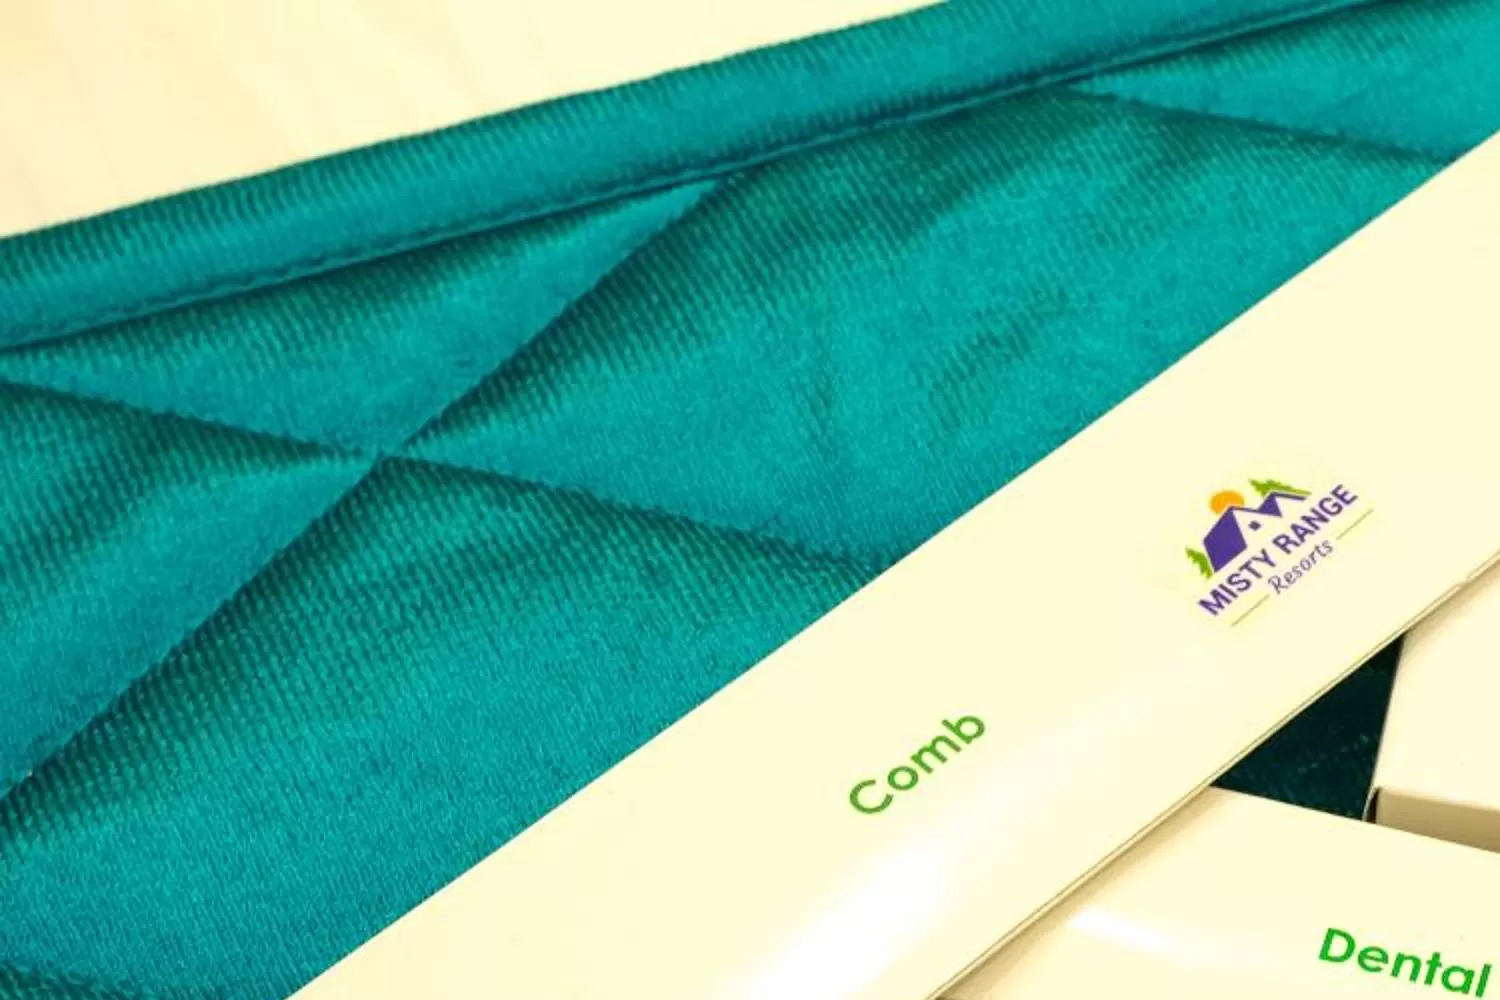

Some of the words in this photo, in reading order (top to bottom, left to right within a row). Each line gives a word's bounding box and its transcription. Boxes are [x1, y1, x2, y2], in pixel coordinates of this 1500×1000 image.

[1197, 548, 1276, 616] MISTY
[1272, 484, 1358, 554] RANGE
[1268, 540, 1333, 594] Resorts
[849, 715, 986, 814] Comb
[1318, 927, 1492, 998] Dental
